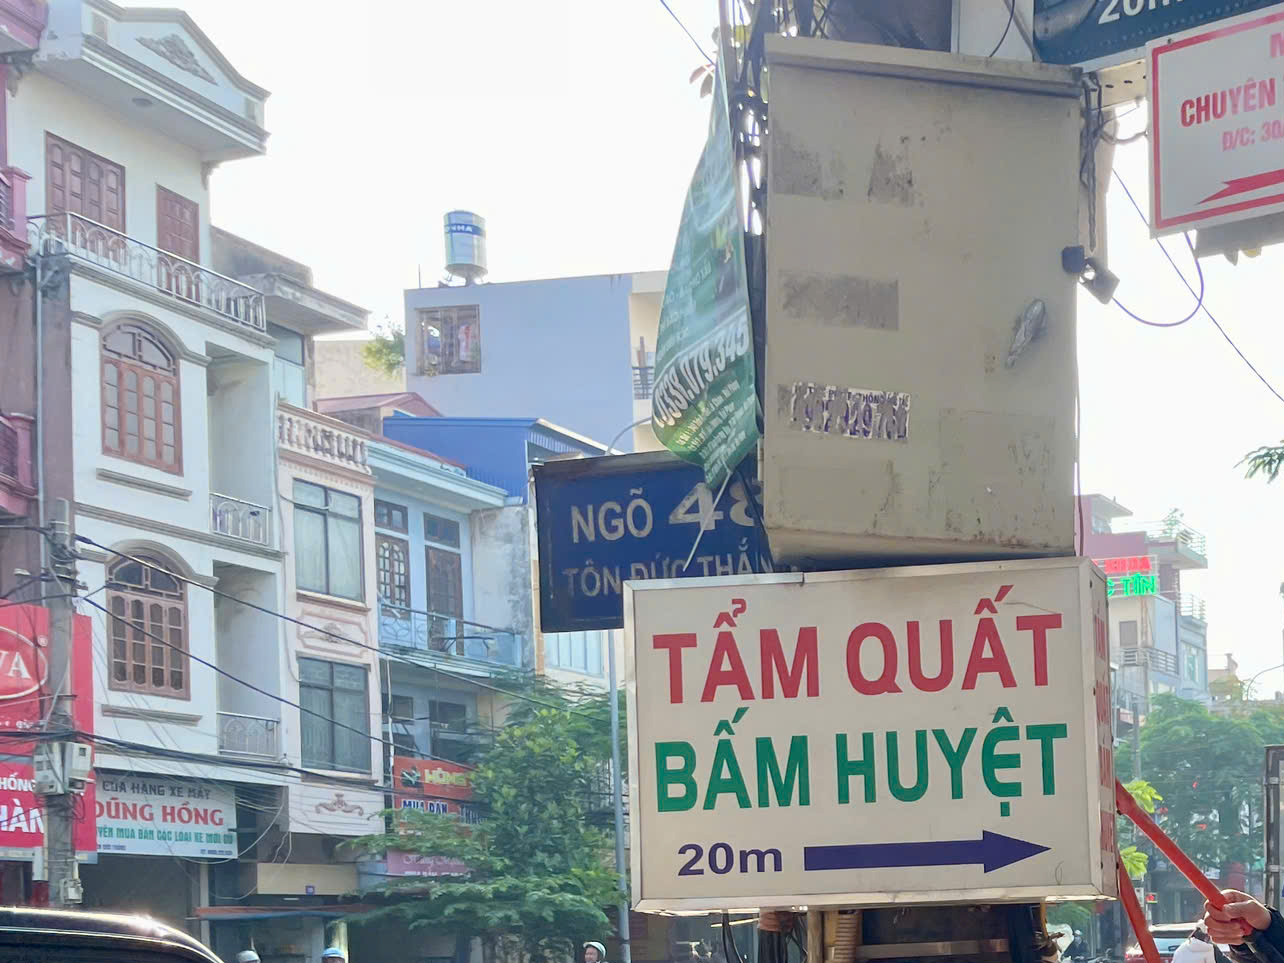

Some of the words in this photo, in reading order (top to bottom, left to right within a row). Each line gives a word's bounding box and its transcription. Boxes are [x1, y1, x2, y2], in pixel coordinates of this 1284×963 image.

[1180, 76, 1276, 127] CHUYÊN
[571, 487, 653, 543] NGÕ
[562, 558, 622, 597] TÔN
[652, 598, 820, 705] TẨM
[846, 584, 1063, 696] QUẤT
[654, 706, 811, 813] BẤM
[835, 706, 1068, 817] HUYỆT
[170, 786, 184, 798] XE
[677, 841, 784, 877] 20m
